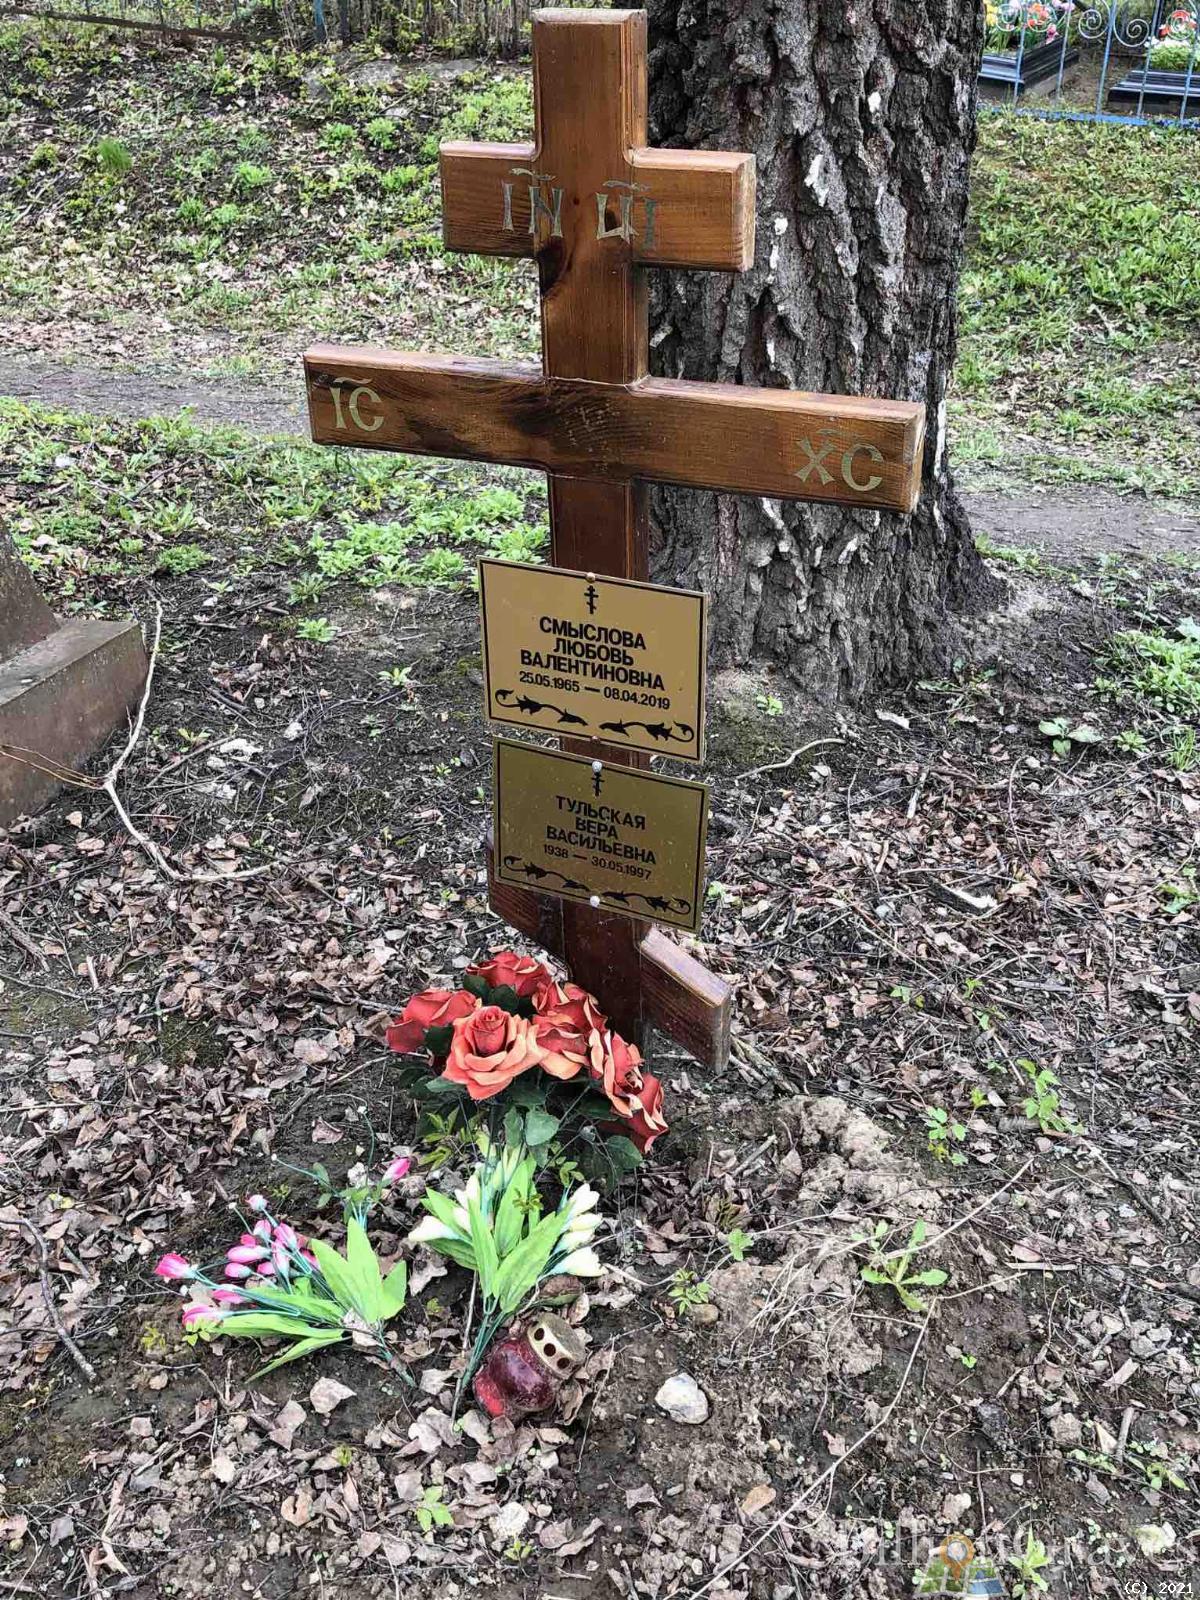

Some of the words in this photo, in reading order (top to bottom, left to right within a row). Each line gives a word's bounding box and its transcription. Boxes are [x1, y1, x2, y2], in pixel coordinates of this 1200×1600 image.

[539, 616, 647, 650] СМЫСЛОВА
[553, 637, 634, 666] ЛЮБОВЬ
[520, 649, 665, 691] ВАЛЕНТИНОВНА
[519, 670, 580, 693] 25.05.1965
[603, 686, 671, 710] 08.04.2019
[555, 795, 646, 830] ТУЛЬСКАЯ
[575, 816, 619, 840] ВЕРА
[543, 844, 569, 859] 1938
[591, 855, 652, 881] 30.05.1997
[546, 825, 657, 865] ВАСИЛЬЕВНА
